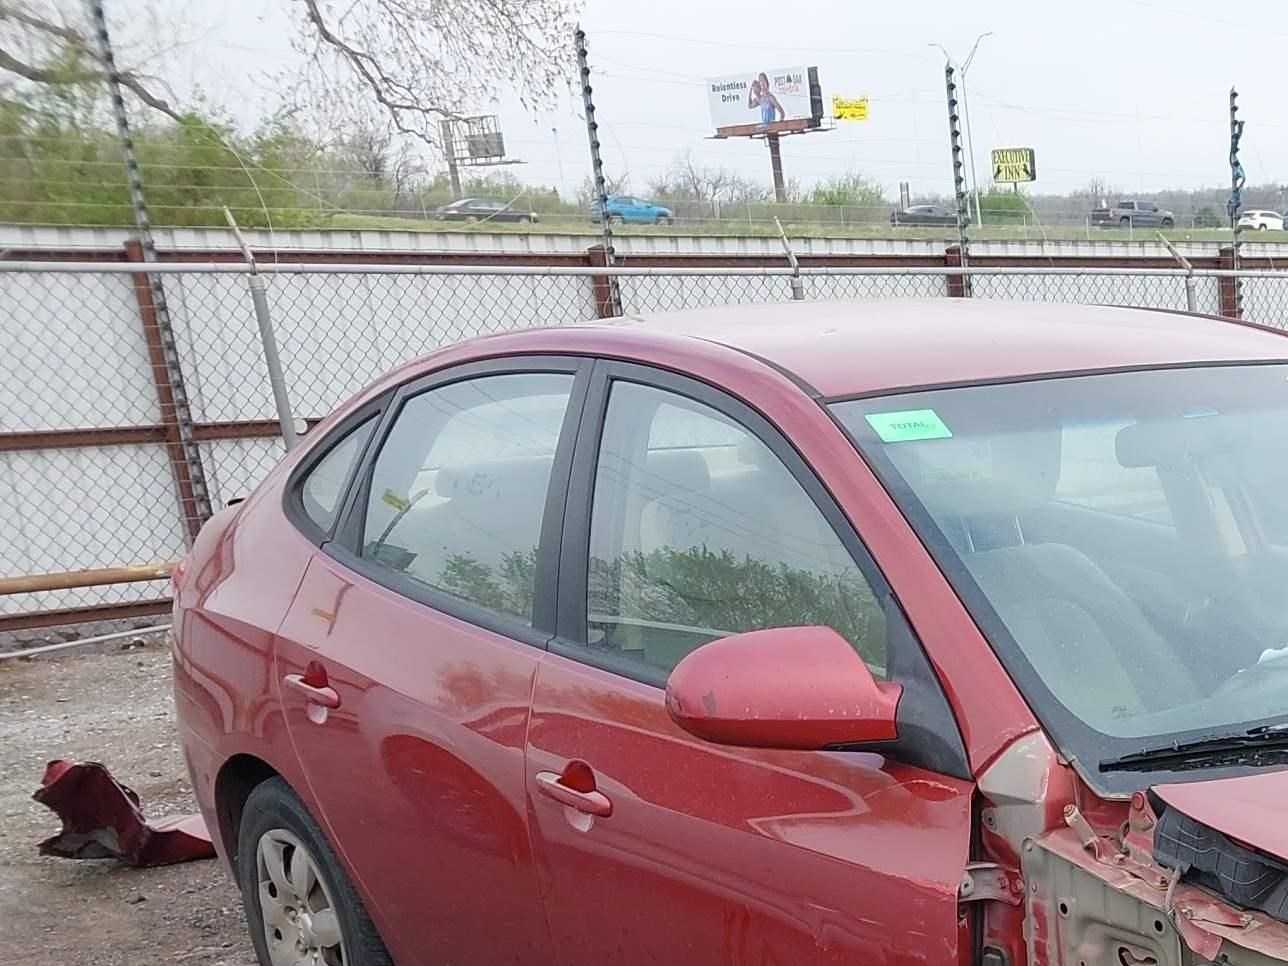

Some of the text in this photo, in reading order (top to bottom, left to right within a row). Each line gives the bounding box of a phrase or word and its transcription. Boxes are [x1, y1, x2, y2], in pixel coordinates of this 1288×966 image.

[721, 93, 740, 103] Drive
[993, 151, 1030, 164] EXECUTIVE
[1004, 164, 1021, 180] INN
